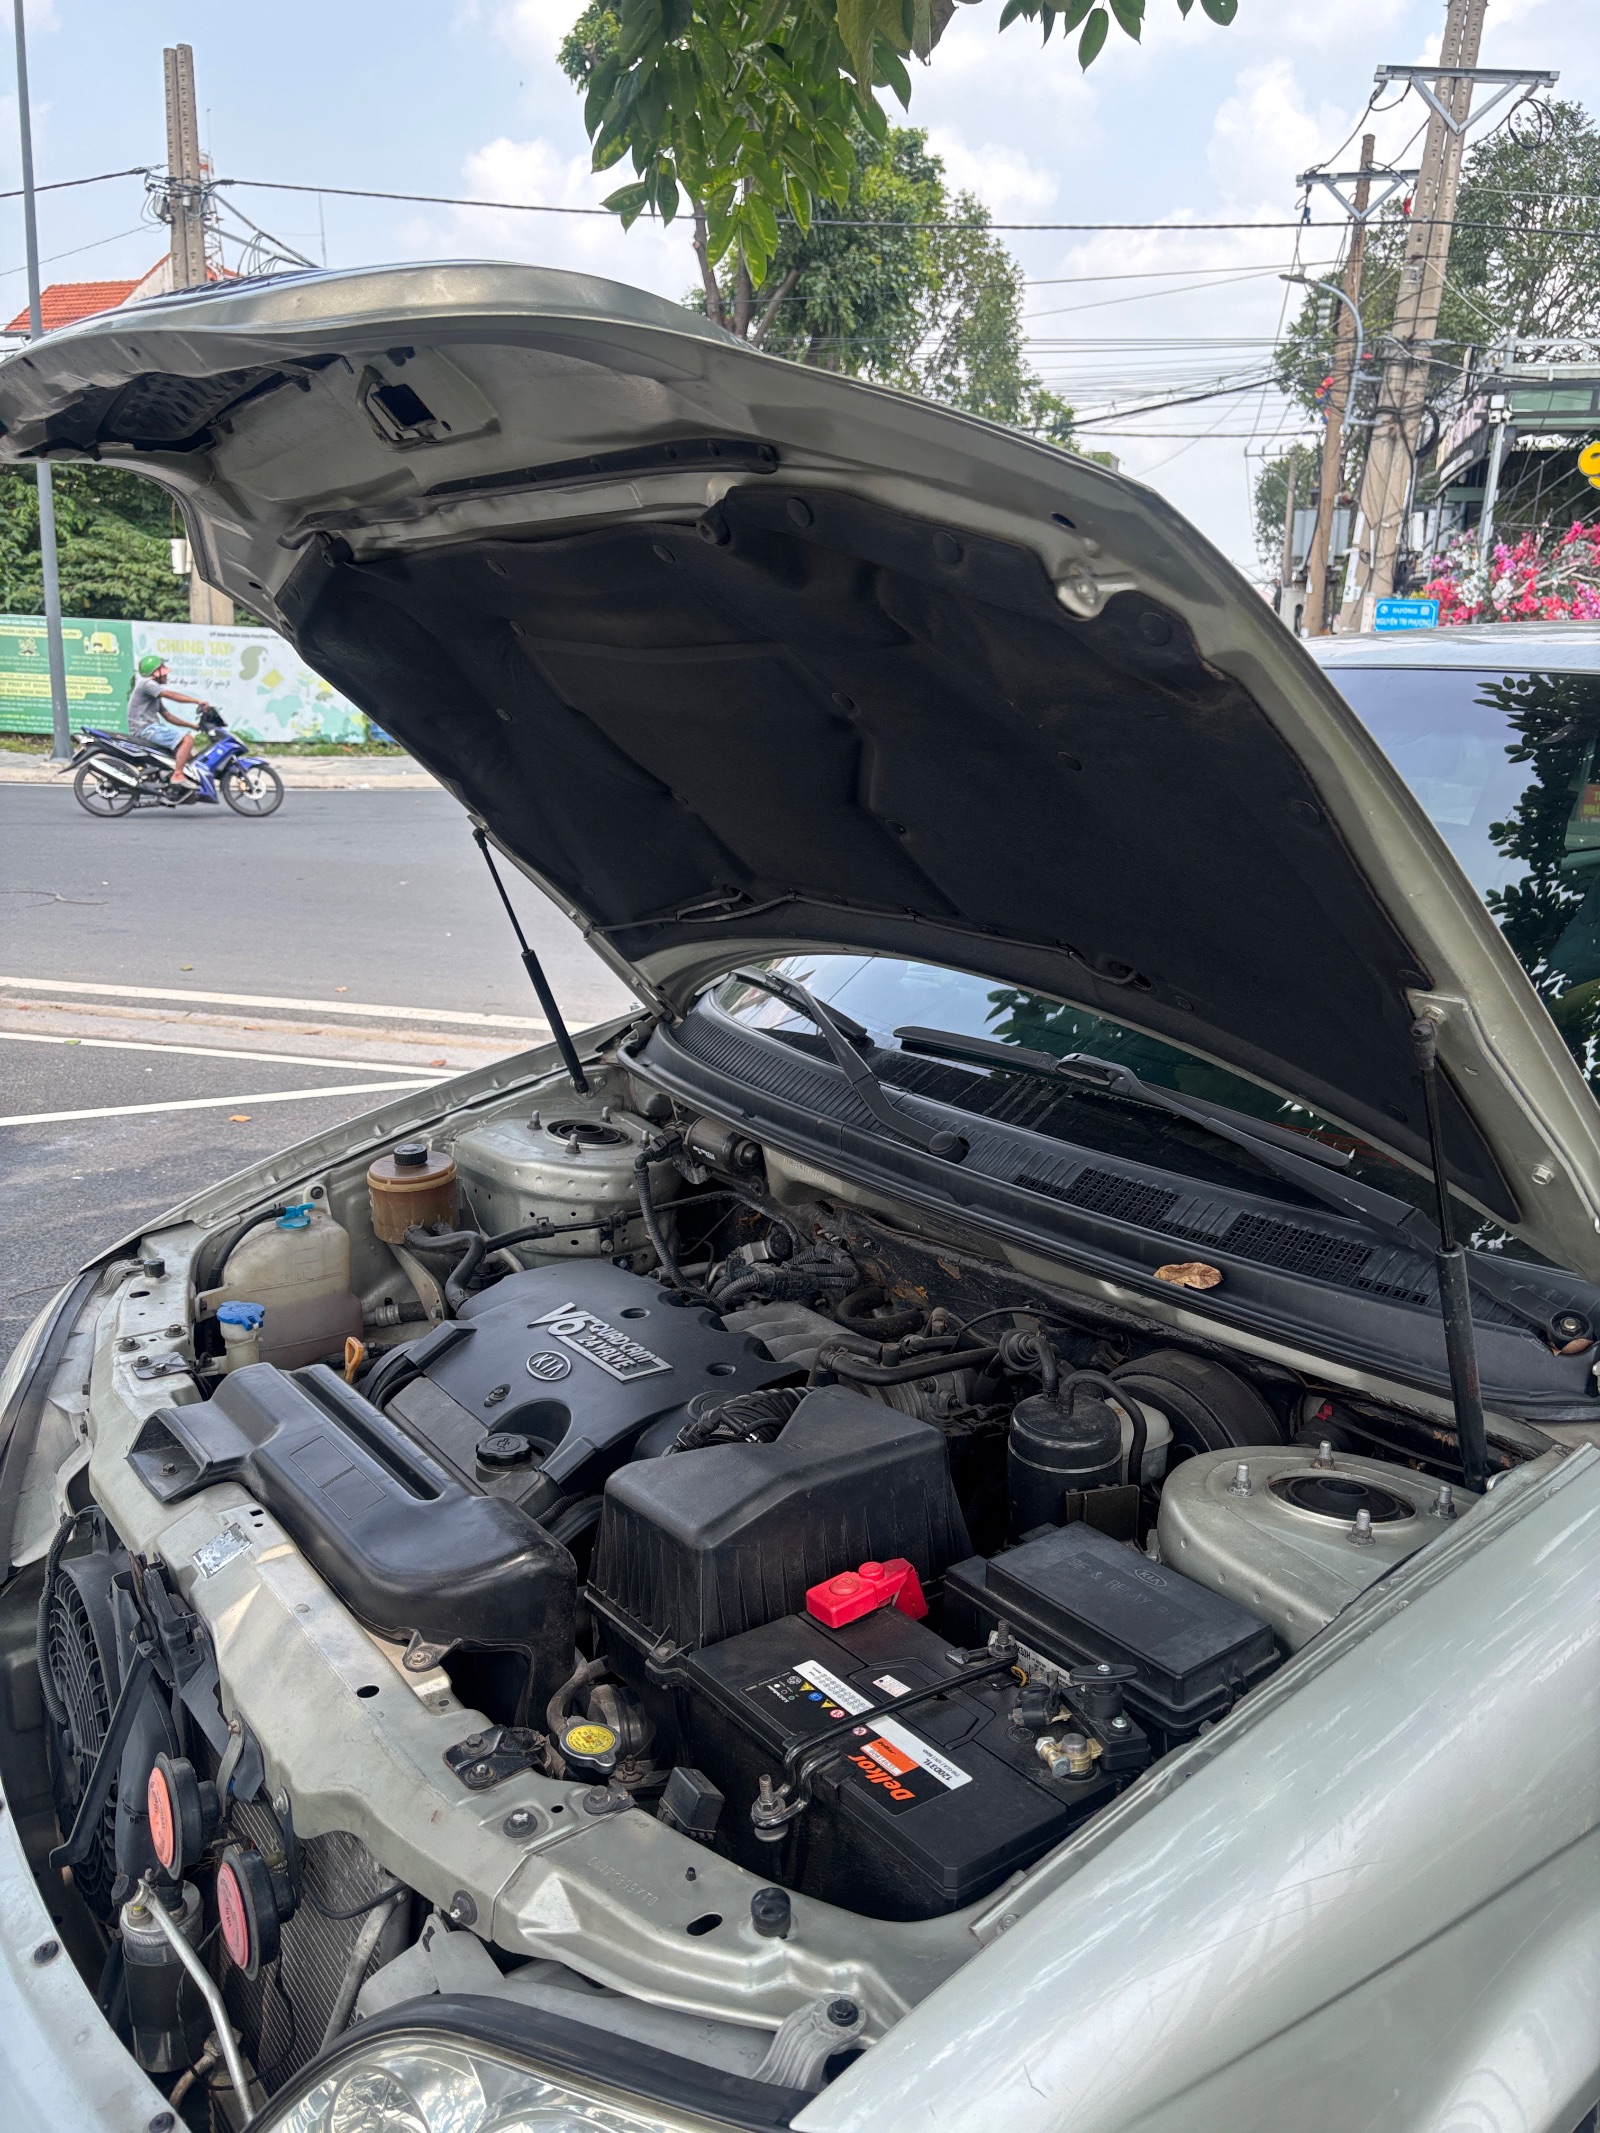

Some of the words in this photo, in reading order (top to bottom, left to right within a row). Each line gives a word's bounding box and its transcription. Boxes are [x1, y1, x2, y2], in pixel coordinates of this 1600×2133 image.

[156, 639, 205, 655] CHUNG
[527, 1302, 589, 1336] V6
[531, 1353, 565, 1378] KIA
[1105, 1579, 1153, 1605] RELAY
[847, 1754, 916, 1801] Delkor
[922, 1758, 953, 1781] 120D31L
